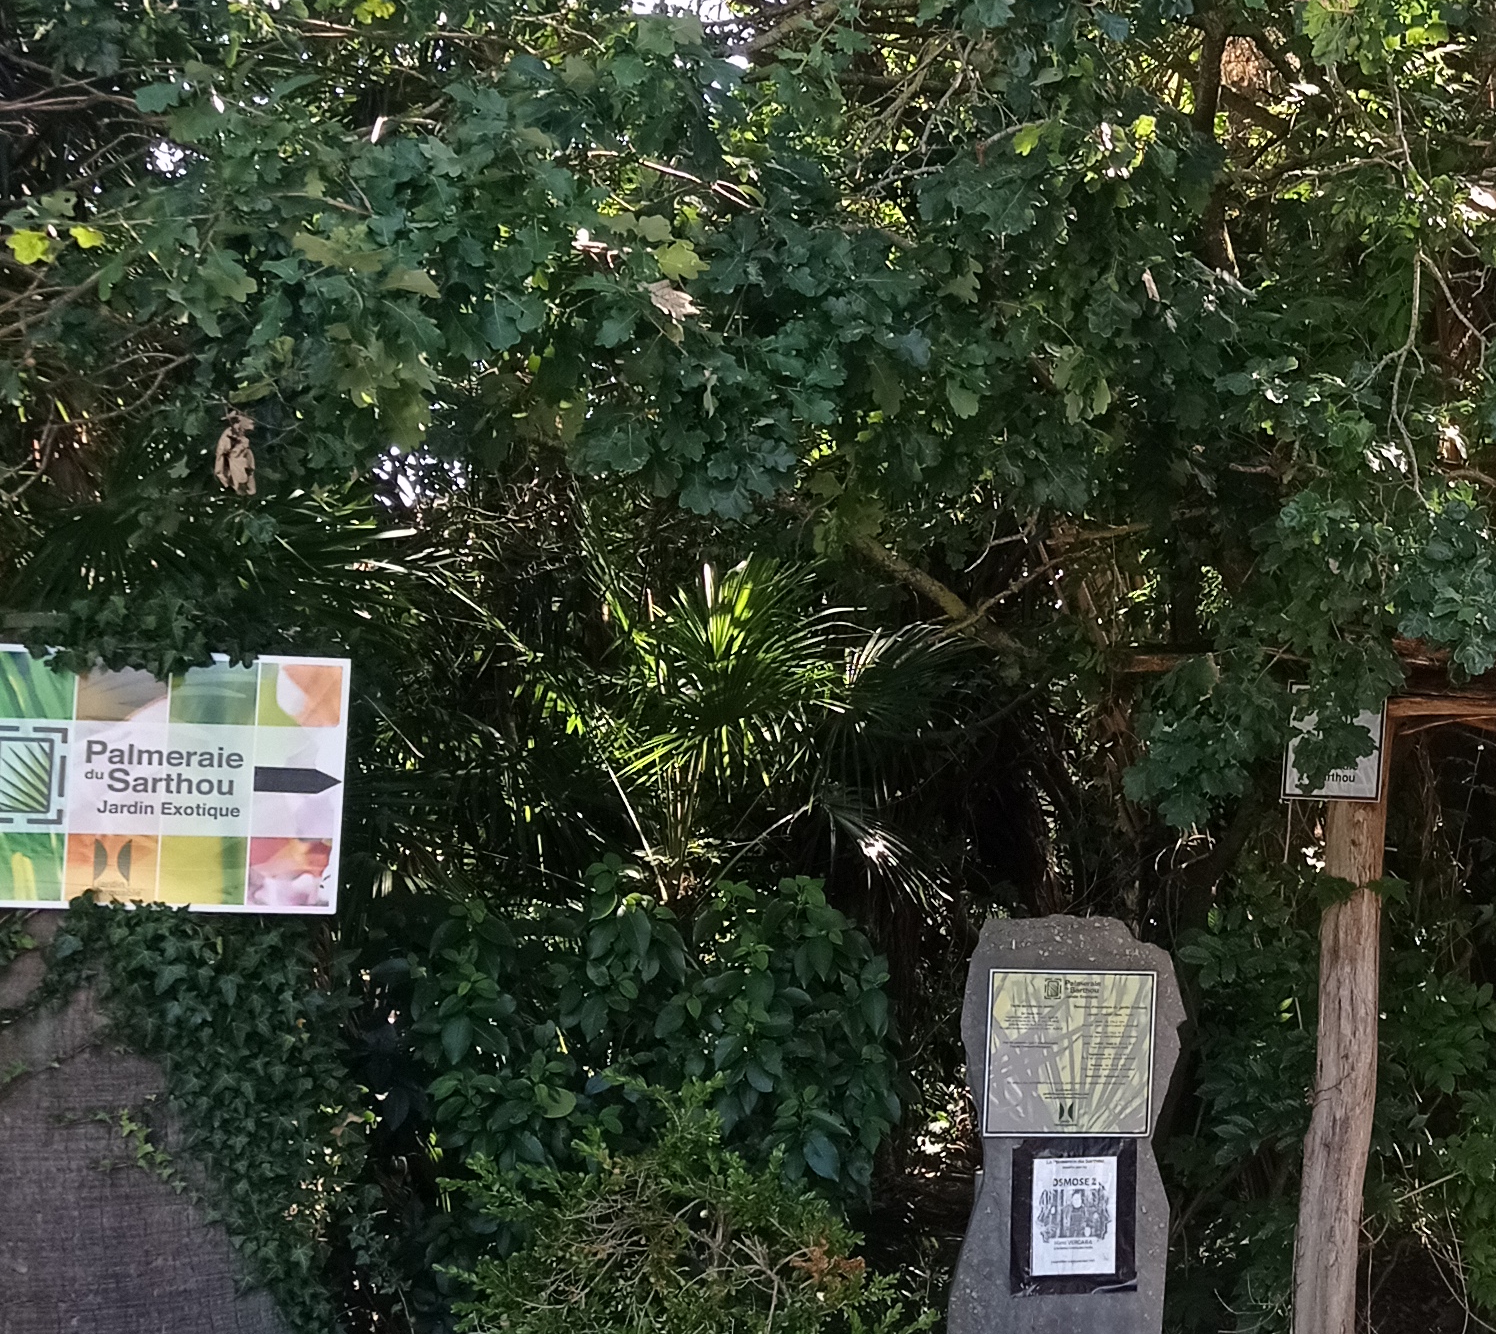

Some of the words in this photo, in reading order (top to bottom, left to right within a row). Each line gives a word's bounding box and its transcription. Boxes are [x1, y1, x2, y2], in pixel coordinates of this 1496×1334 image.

[85, 739, 244, 769] Palmeraie
[84, 768, 104, 780] du
[107, 768, 235, 796] Sarthou
[97, 800, 155, 815] Jardin
[160, 801, 241, 820] Exotique
